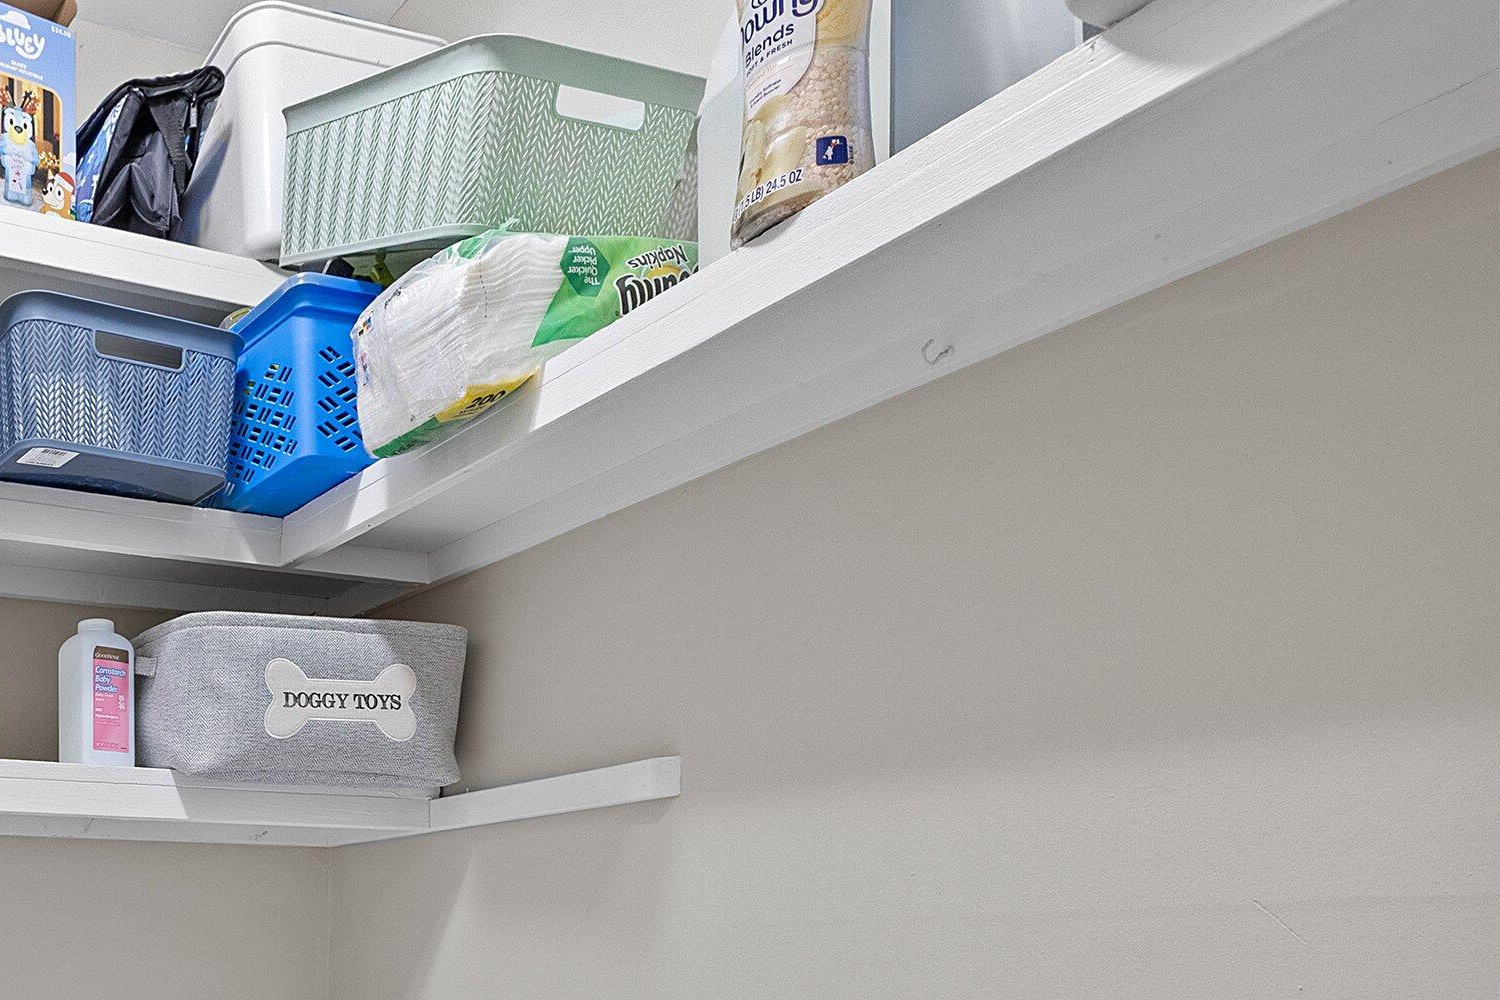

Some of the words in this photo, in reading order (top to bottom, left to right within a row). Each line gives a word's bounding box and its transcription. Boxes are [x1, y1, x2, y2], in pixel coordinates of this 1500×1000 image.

[766, 39, 793, 58] FRESH
[765, 174, 787, 195] 24.5
[788, 169, 803, 185] OZ
[572, 255, 598, 266] Picker
[628, 245, 688, 269] Napkins
[567, 265, 599, 276] Quicker
[584, 275, 600, 286] The
[94, 675, 111, 685] Baby
[94, 684, 118, 693] Powder
[283, 691, 349, 709] DOGGY
[353, 693, 402, 710] TOYS
